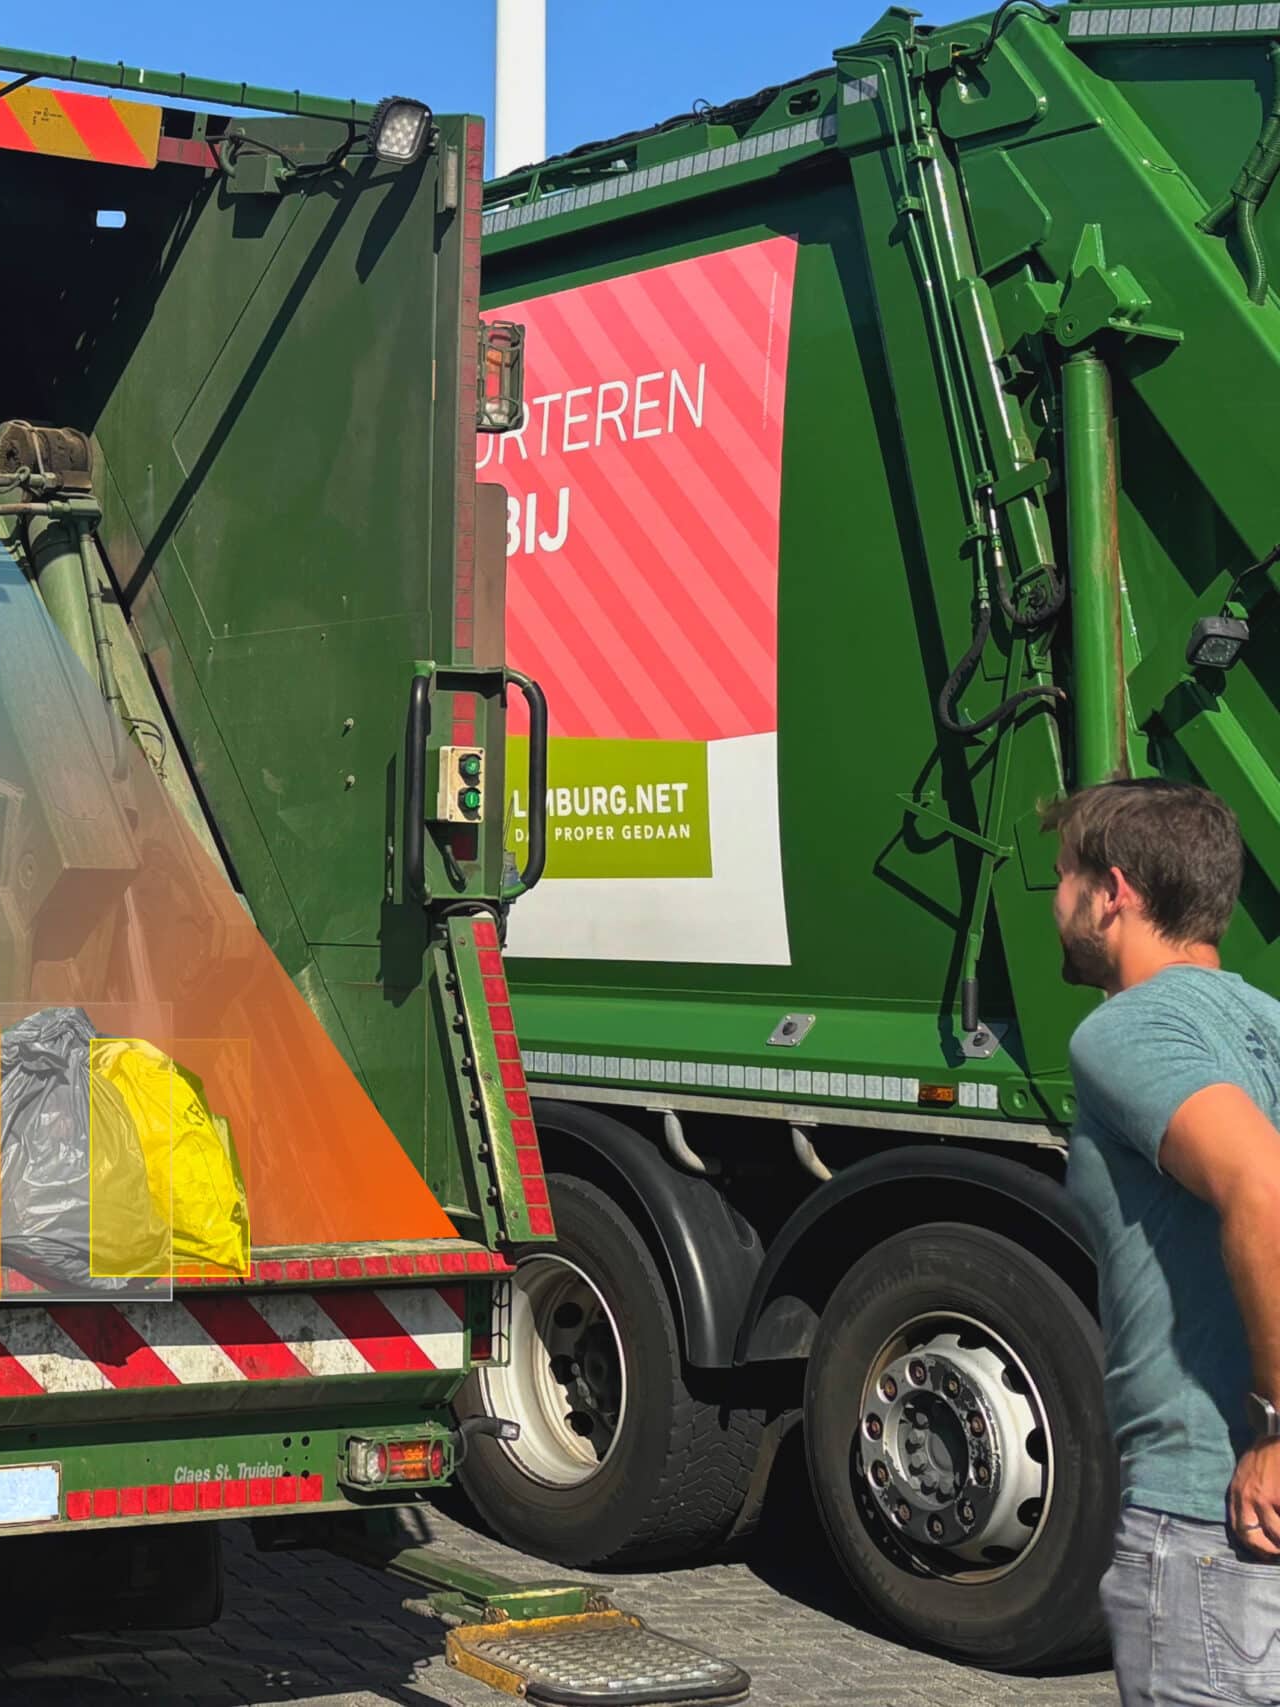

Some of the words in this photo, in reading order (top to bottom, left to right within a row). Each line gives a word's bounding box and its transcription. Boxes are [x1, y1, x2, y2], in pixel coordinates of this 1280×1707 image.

[474, 363, 706, 470] RTEREN
[513, 782, 689, 818] LBURG.NET
[554, 826, 615, 841] PROPER
[621, 823, 691, 840] GEDAAN
[174, 1465, 211, 1484] Claes
[214, 1463, 232, 1481] St.
[236, 1460, 284, 1480] Truiden
